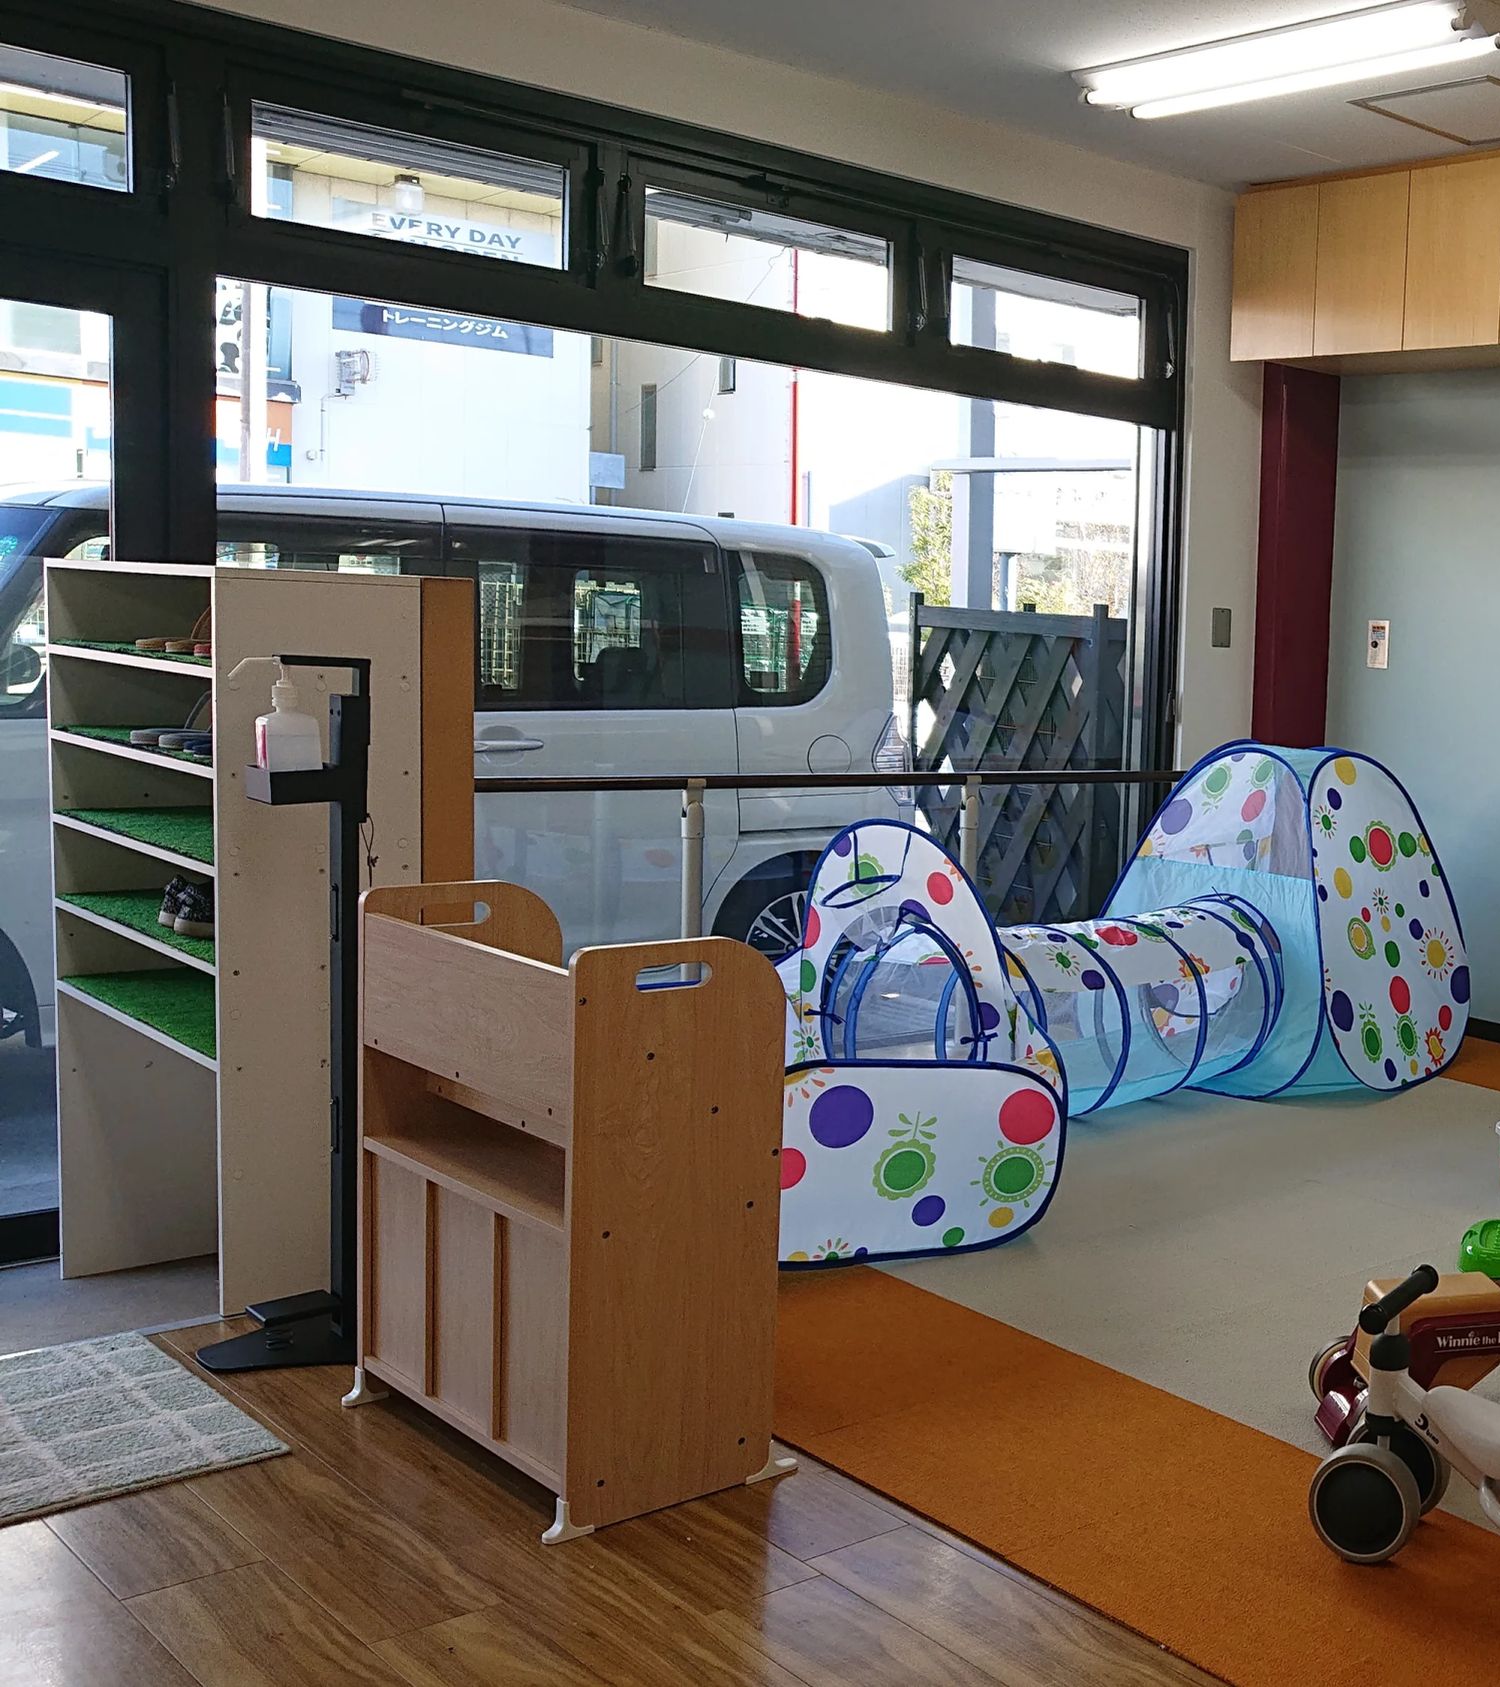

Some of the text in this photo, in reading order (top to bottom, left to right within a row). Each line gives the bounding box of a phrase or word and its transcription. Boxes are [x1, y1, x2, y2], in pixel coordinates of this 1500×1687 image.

[372, 213, 522, 250] EVERY DAY
[382, 309, 509, 339] トレーニングジム
[1436, 1334, 1480, 1348] Winnie
[1482, 1336, 1497, 1345] the
